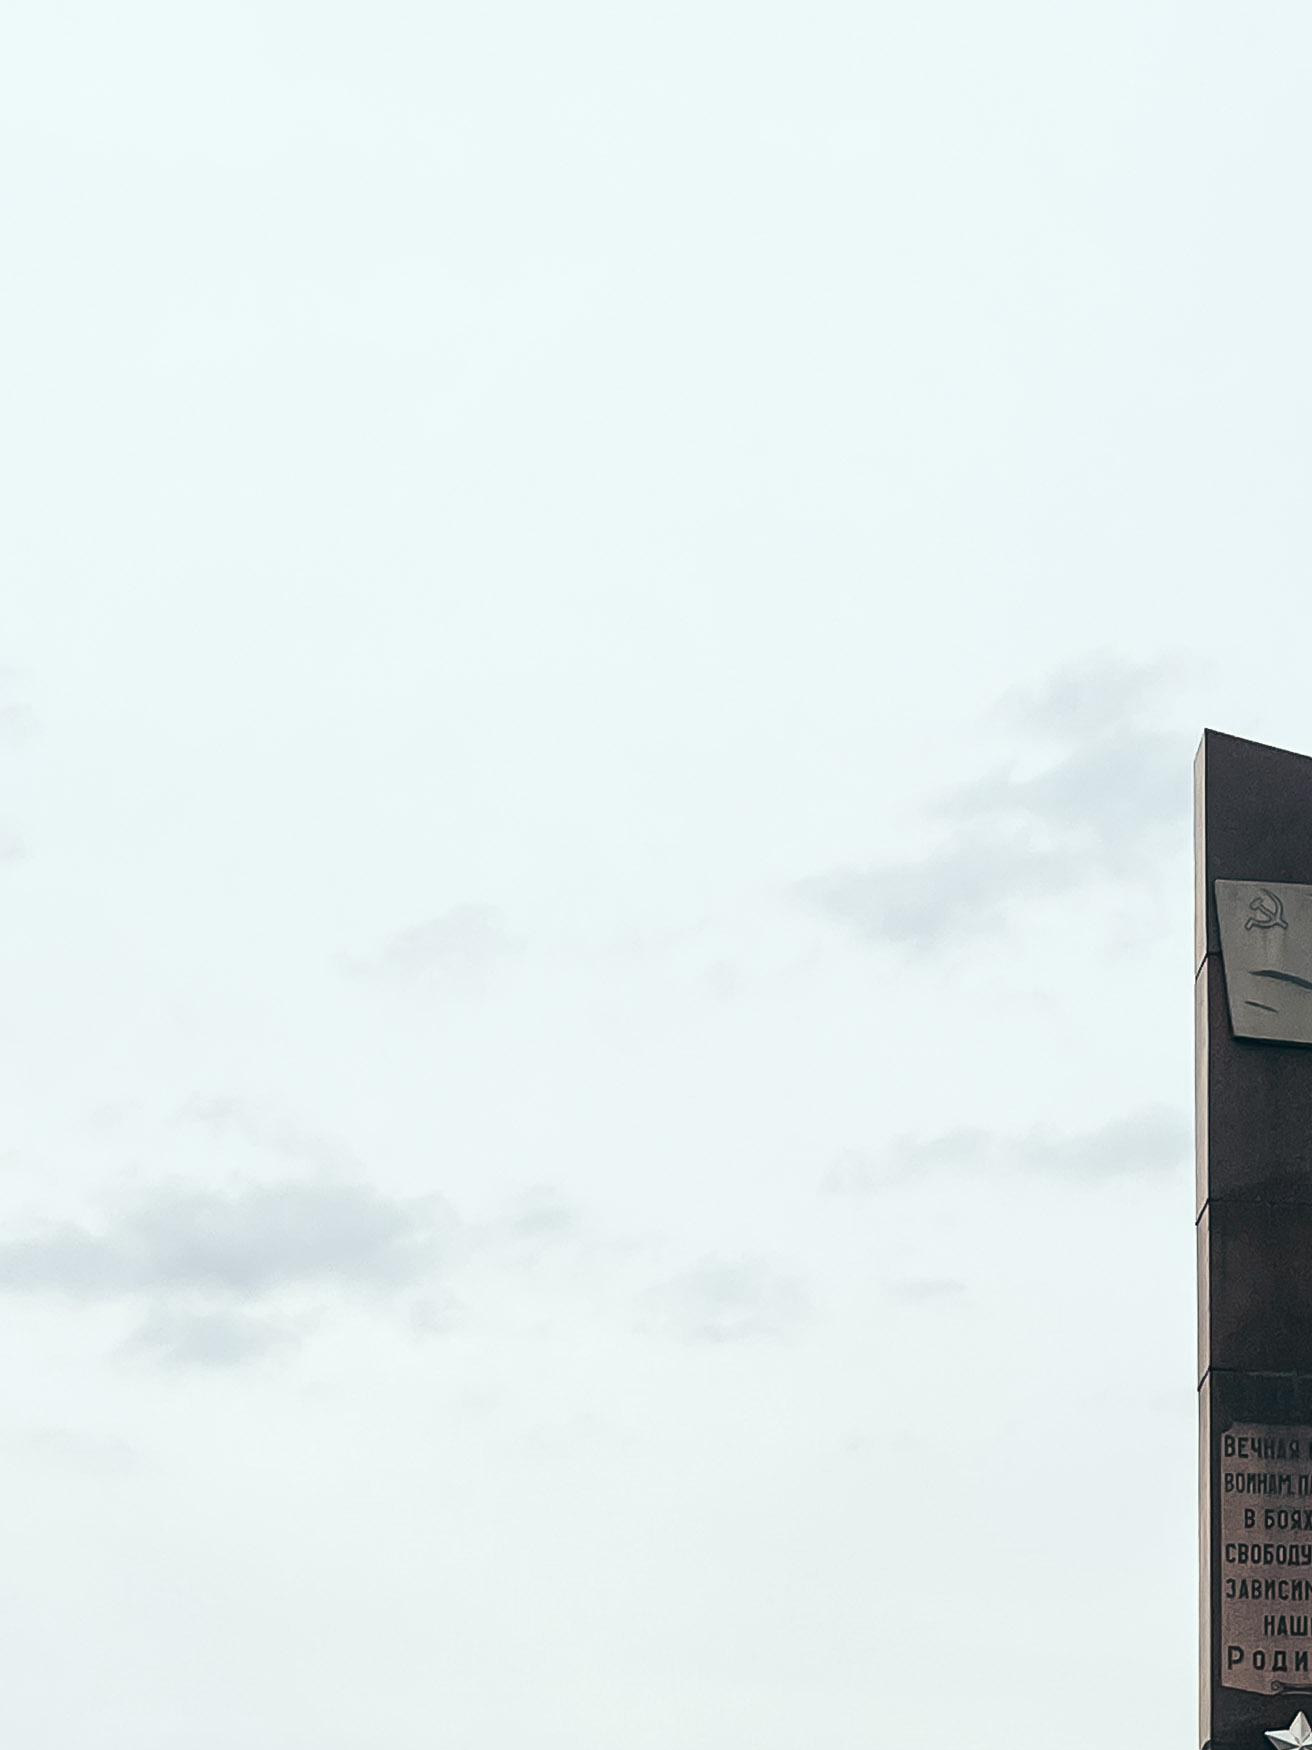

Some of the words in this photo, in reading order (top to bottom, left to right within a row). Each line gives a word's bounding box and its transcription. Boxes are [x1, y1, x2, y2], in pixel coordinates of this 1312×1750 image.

[1224, 1434, 1299, 1460] ВЕЧНАЯ
[1244, 1509, 1256, 1529] В
[1225, 1543, 1312, 1567] СВОБОДУ
